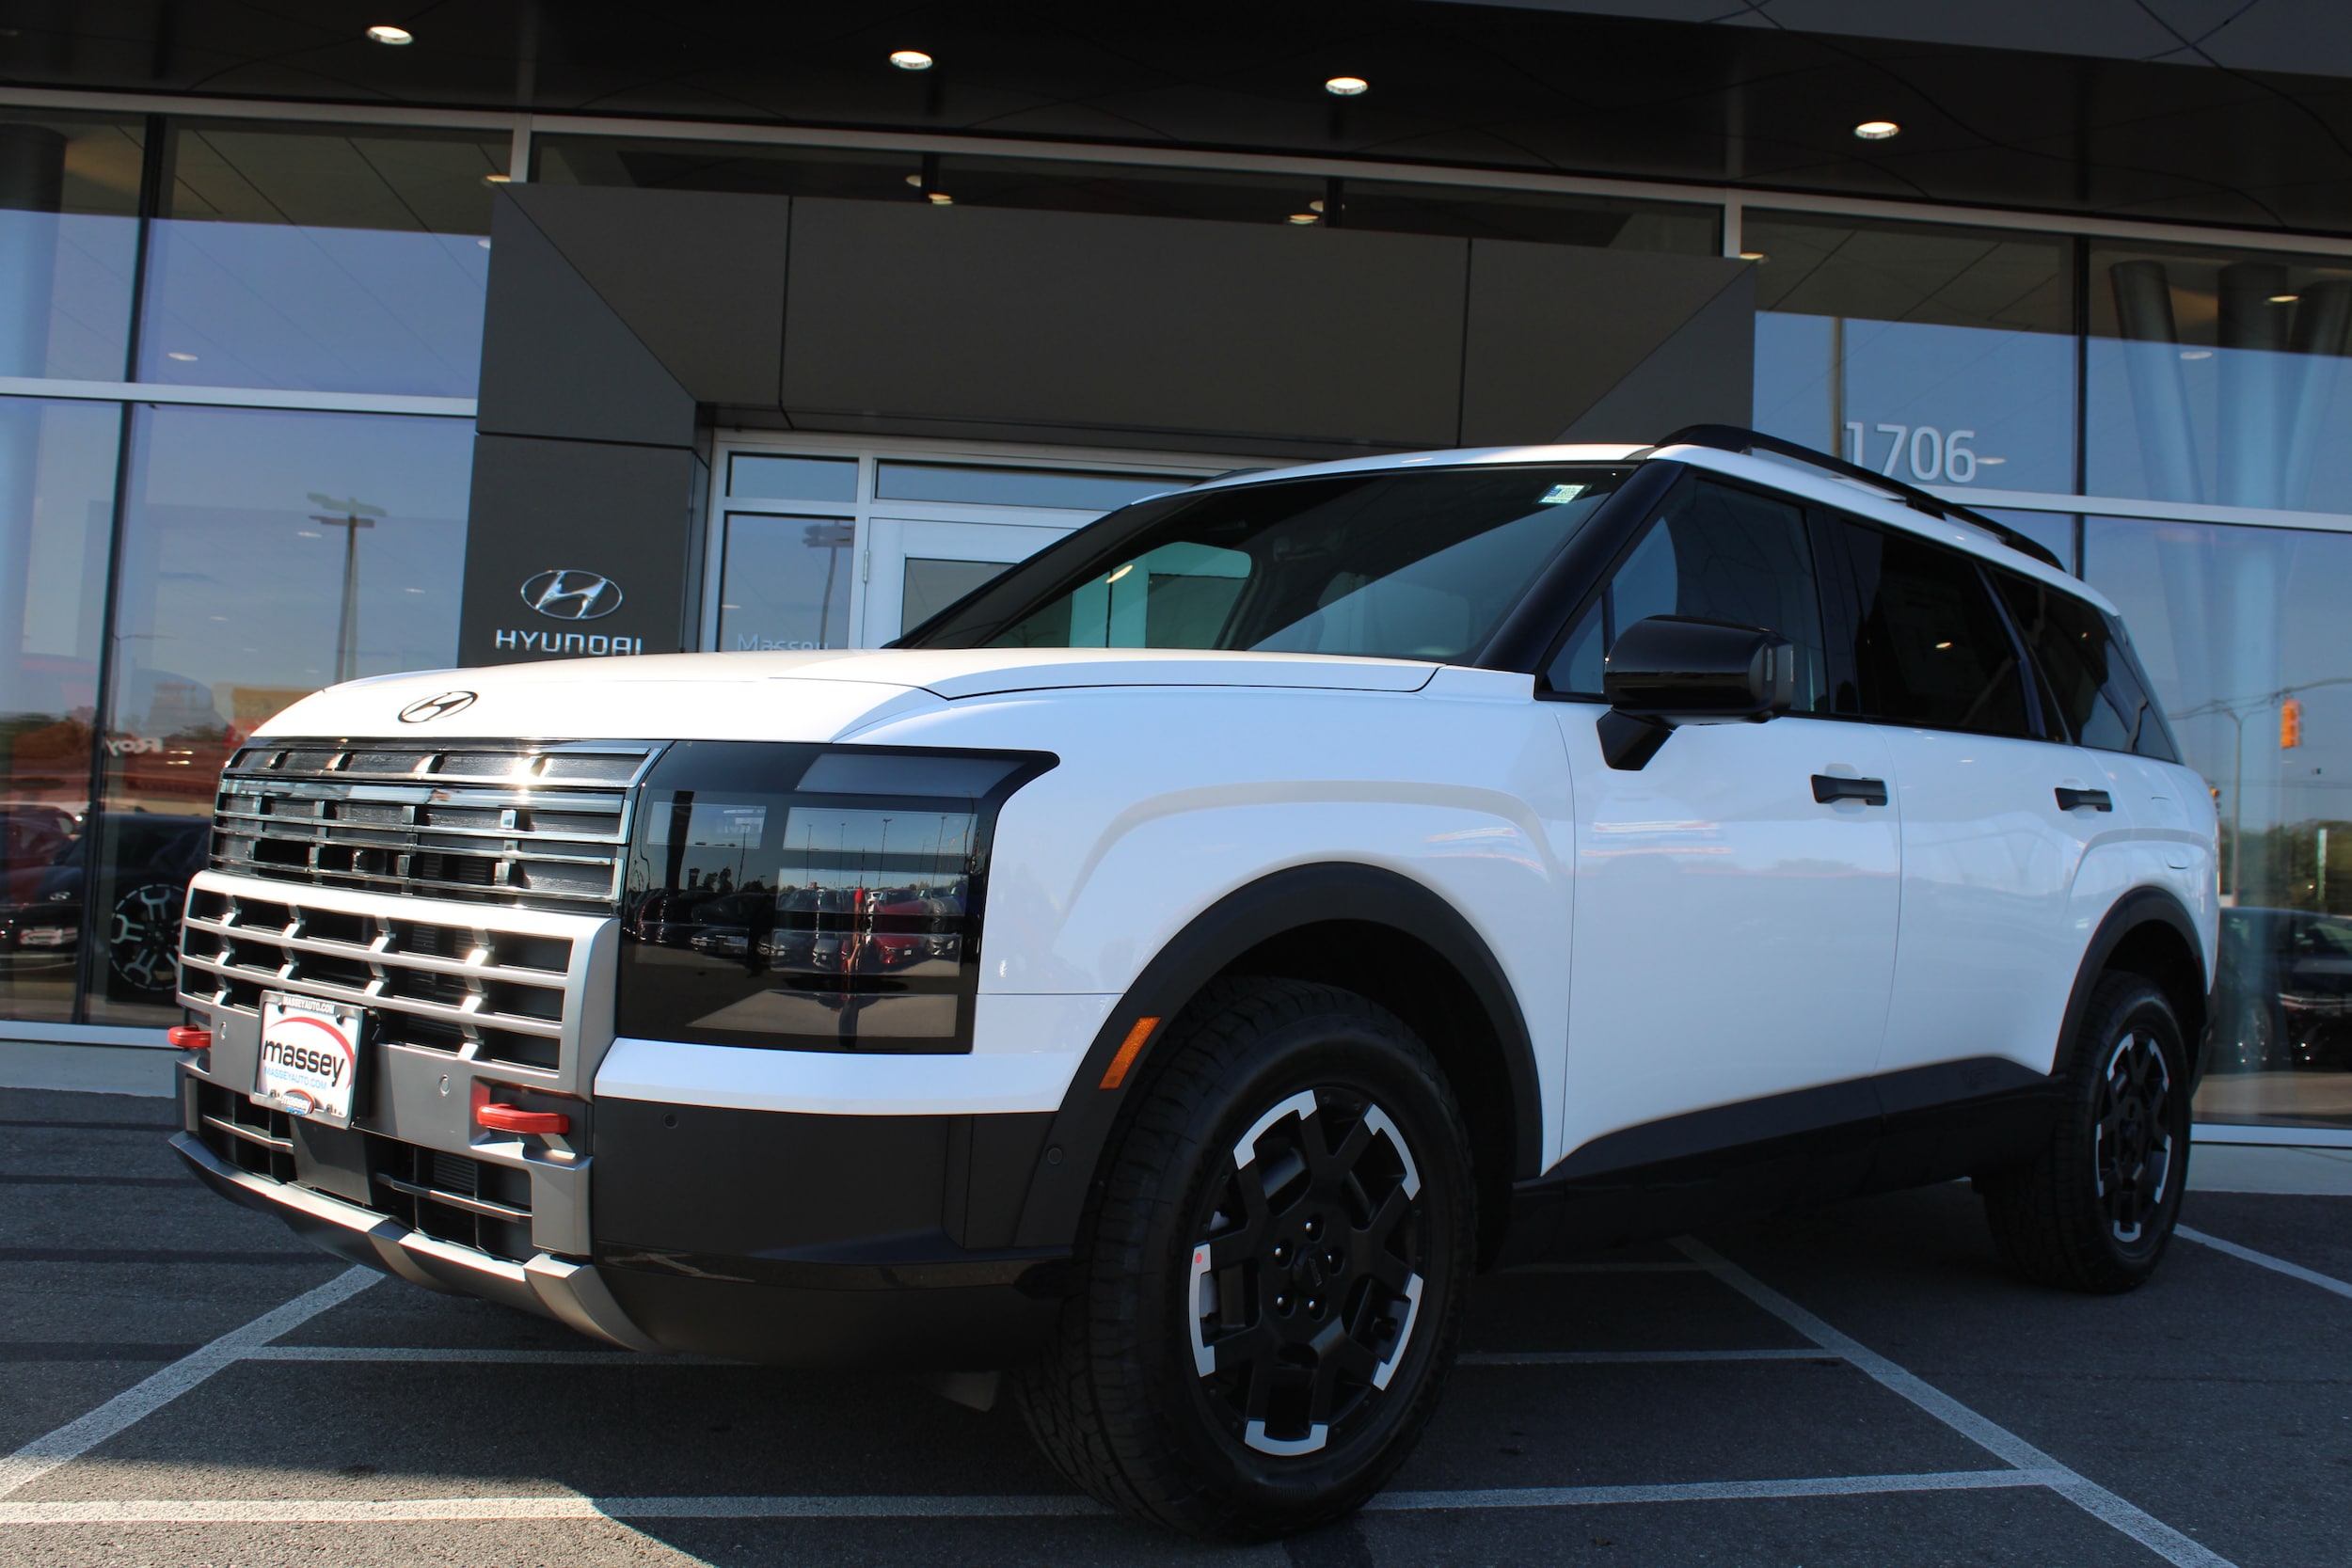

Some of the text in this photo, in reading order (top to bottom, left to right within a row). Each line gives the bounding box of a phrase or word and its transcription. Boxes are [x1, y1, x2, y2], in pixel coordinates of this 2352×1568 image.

[1846, 421, 1977, 483] 1706
[495, 628, 642, 657] HYUNDAI
[283, 996, 336, 1015] MASSEYAUTO.COM
[262, 1039, 345, 1087] massey
[263, 1066, 327, 1091] MASSEYAUTO.COM
